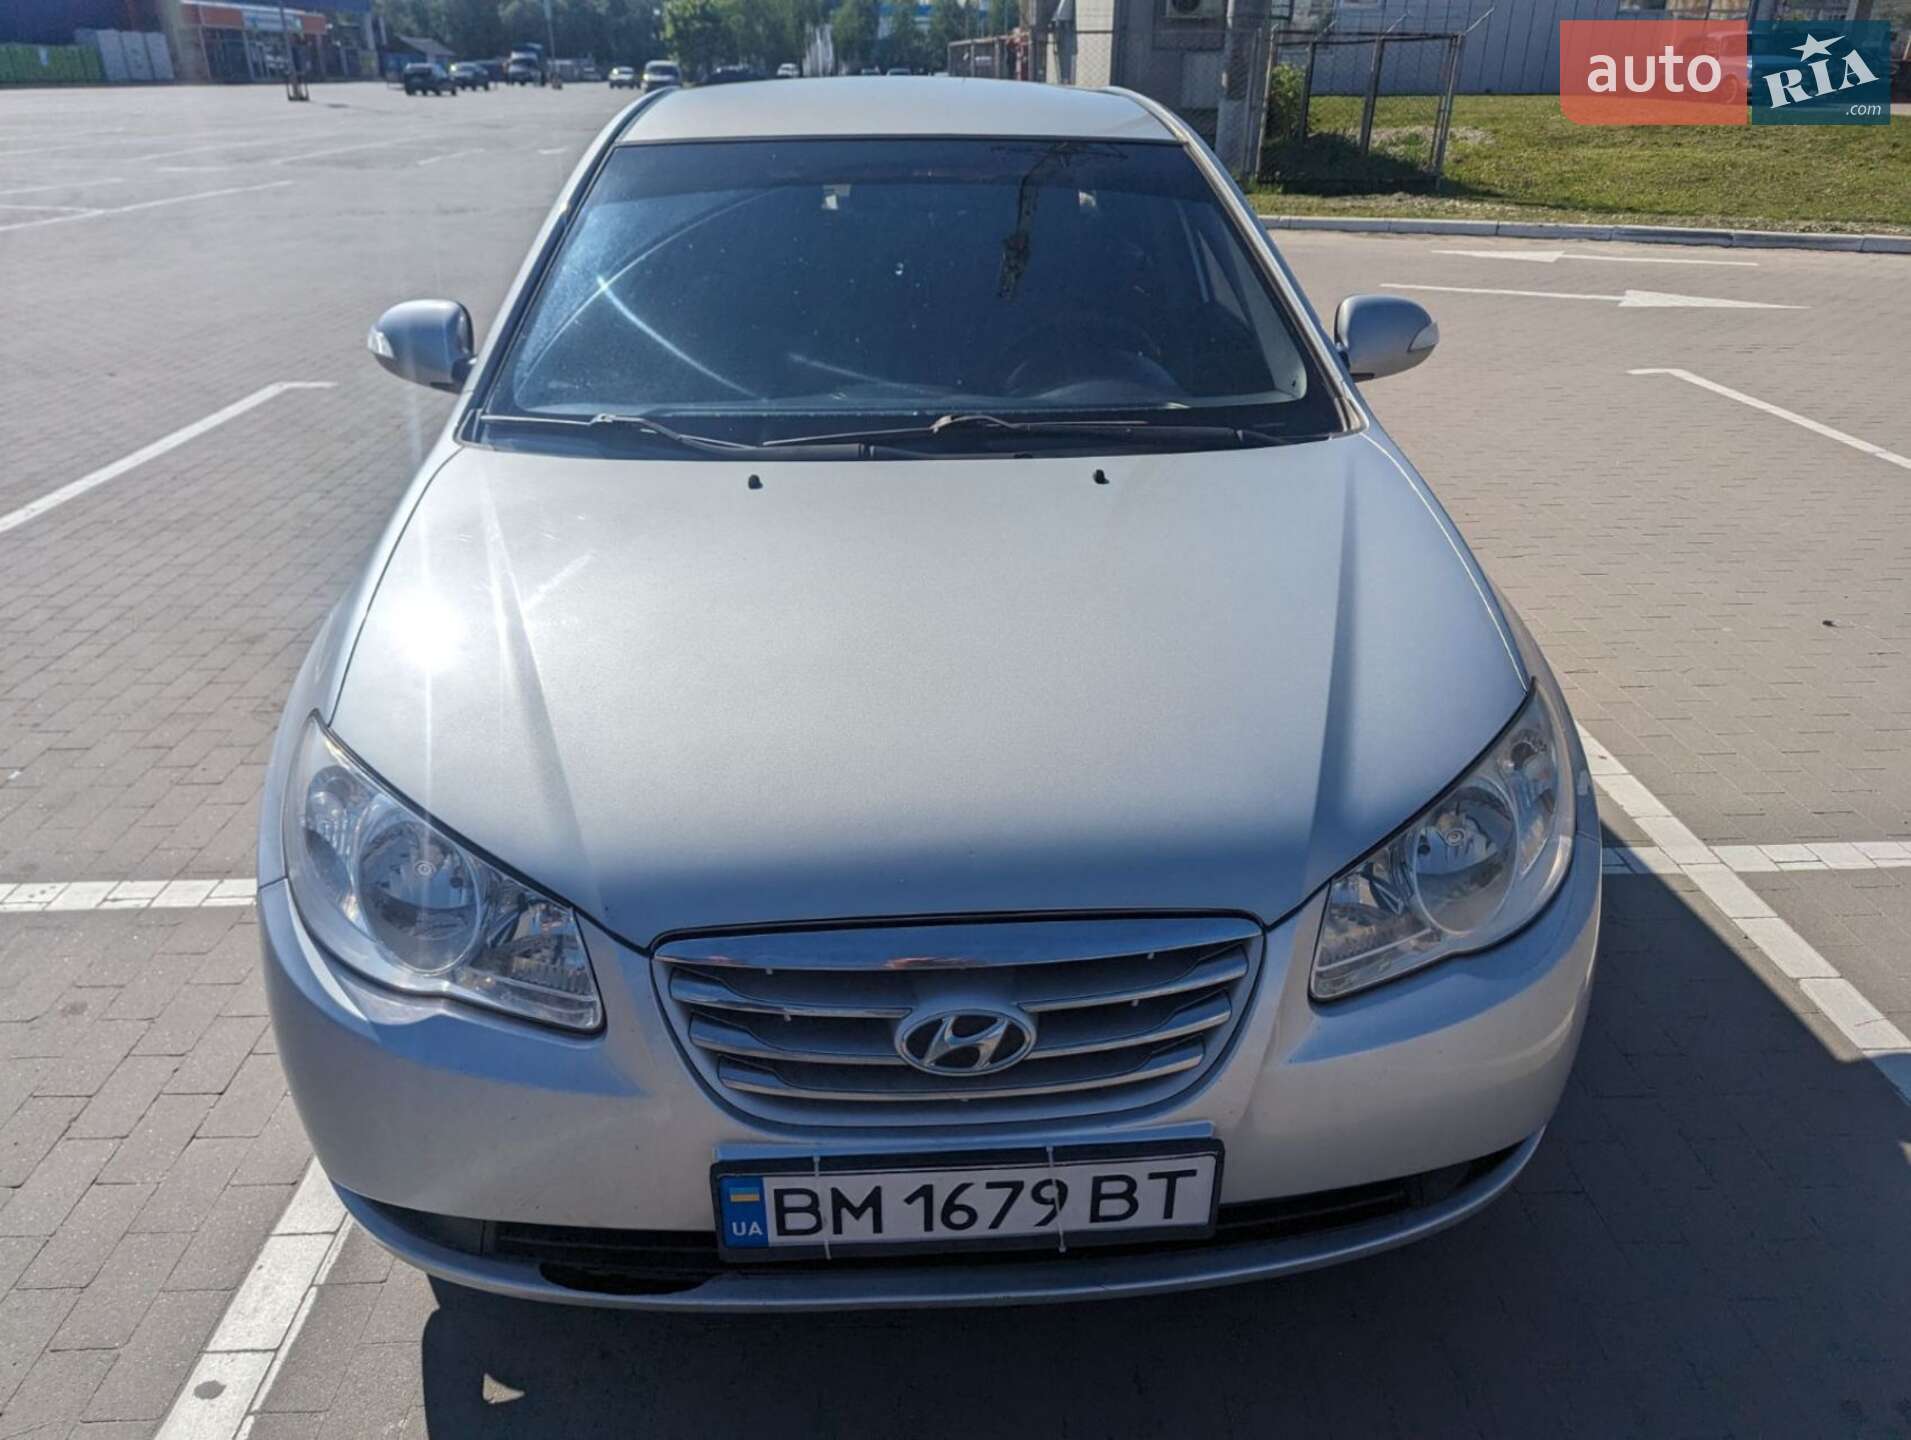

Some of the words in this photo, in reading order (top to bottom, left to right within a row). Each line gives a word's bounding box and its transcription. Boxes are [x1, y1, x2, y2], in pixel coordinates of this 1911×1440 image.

[772, 1185, 883, 1237] BM
[903, 1178, 1069, 1232] 1679
[1088, 1168, 1199, 1224] BT
[731, 1221, 764, 1237] UA
